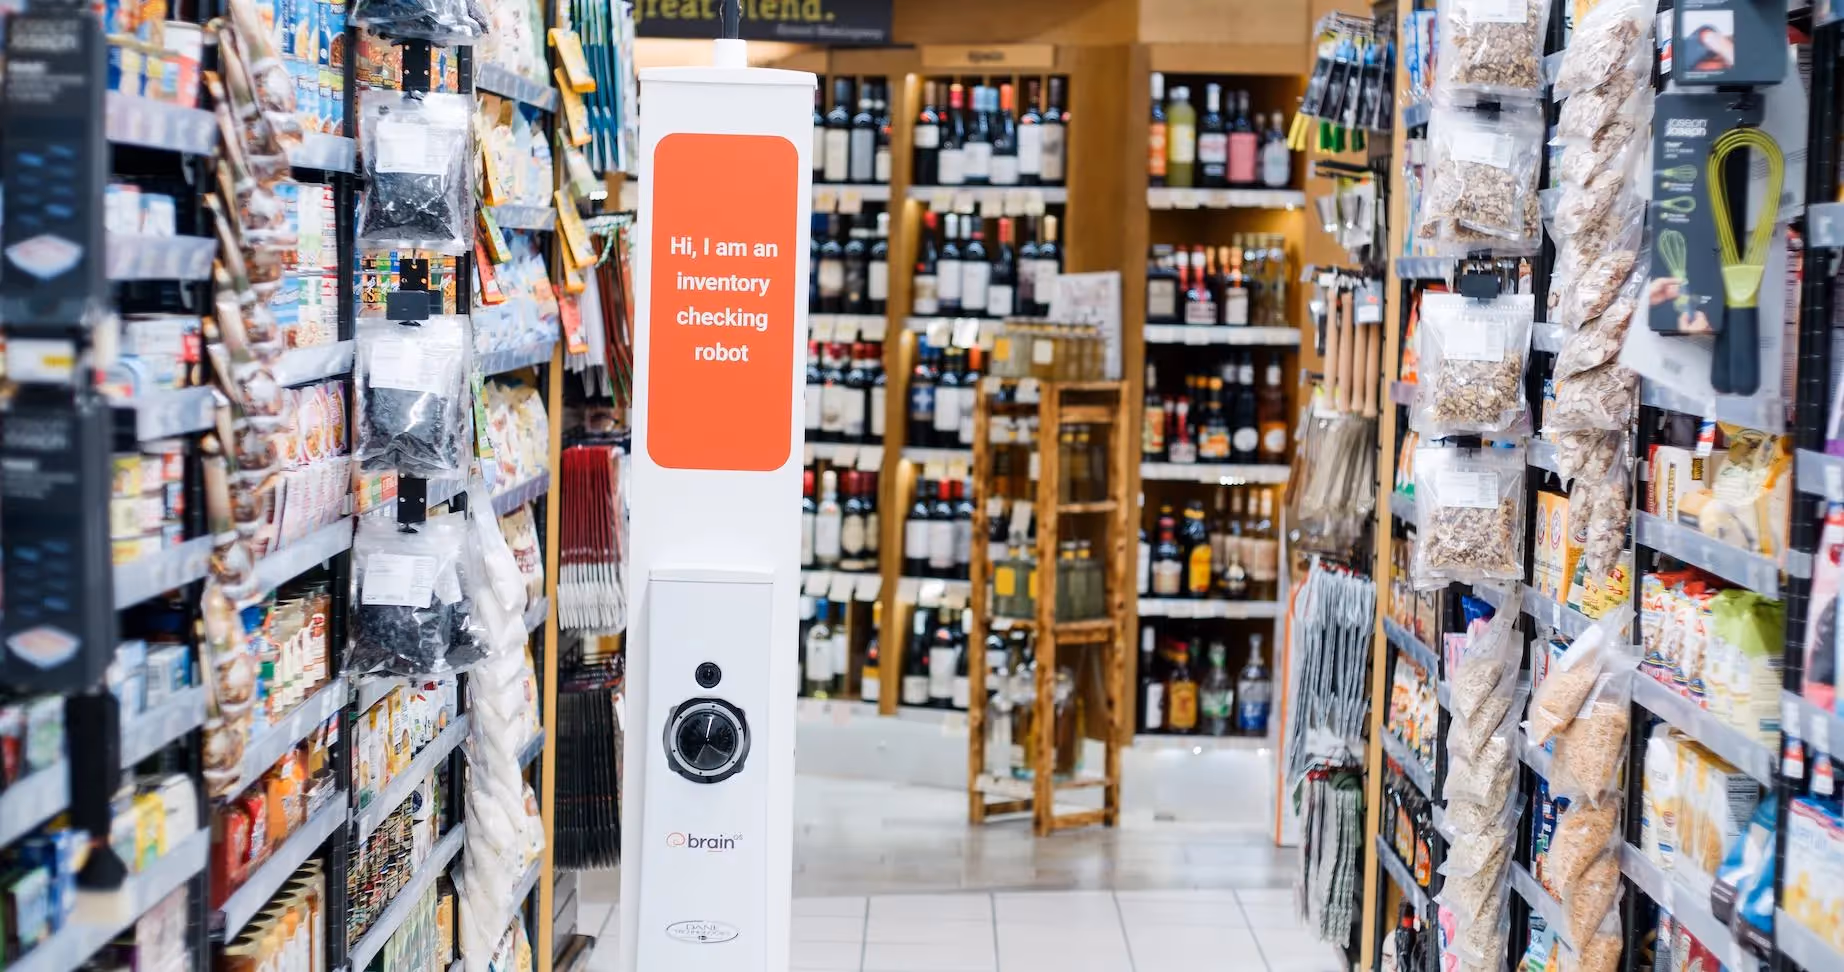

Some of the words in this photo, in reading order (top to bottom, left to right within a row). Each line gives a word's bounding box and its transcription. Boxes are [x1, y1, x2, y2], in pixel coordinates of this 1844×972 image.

[670, 236, 697, 259] Hi,
[703, 237, 710, 256] I
[715, 241, 747, 257] am
[753, 242, 778, 257] an
[676, 271, 771, 297] inventory
[676, 305, 768, 332] checking
[694, 341, 749, 362] robot
